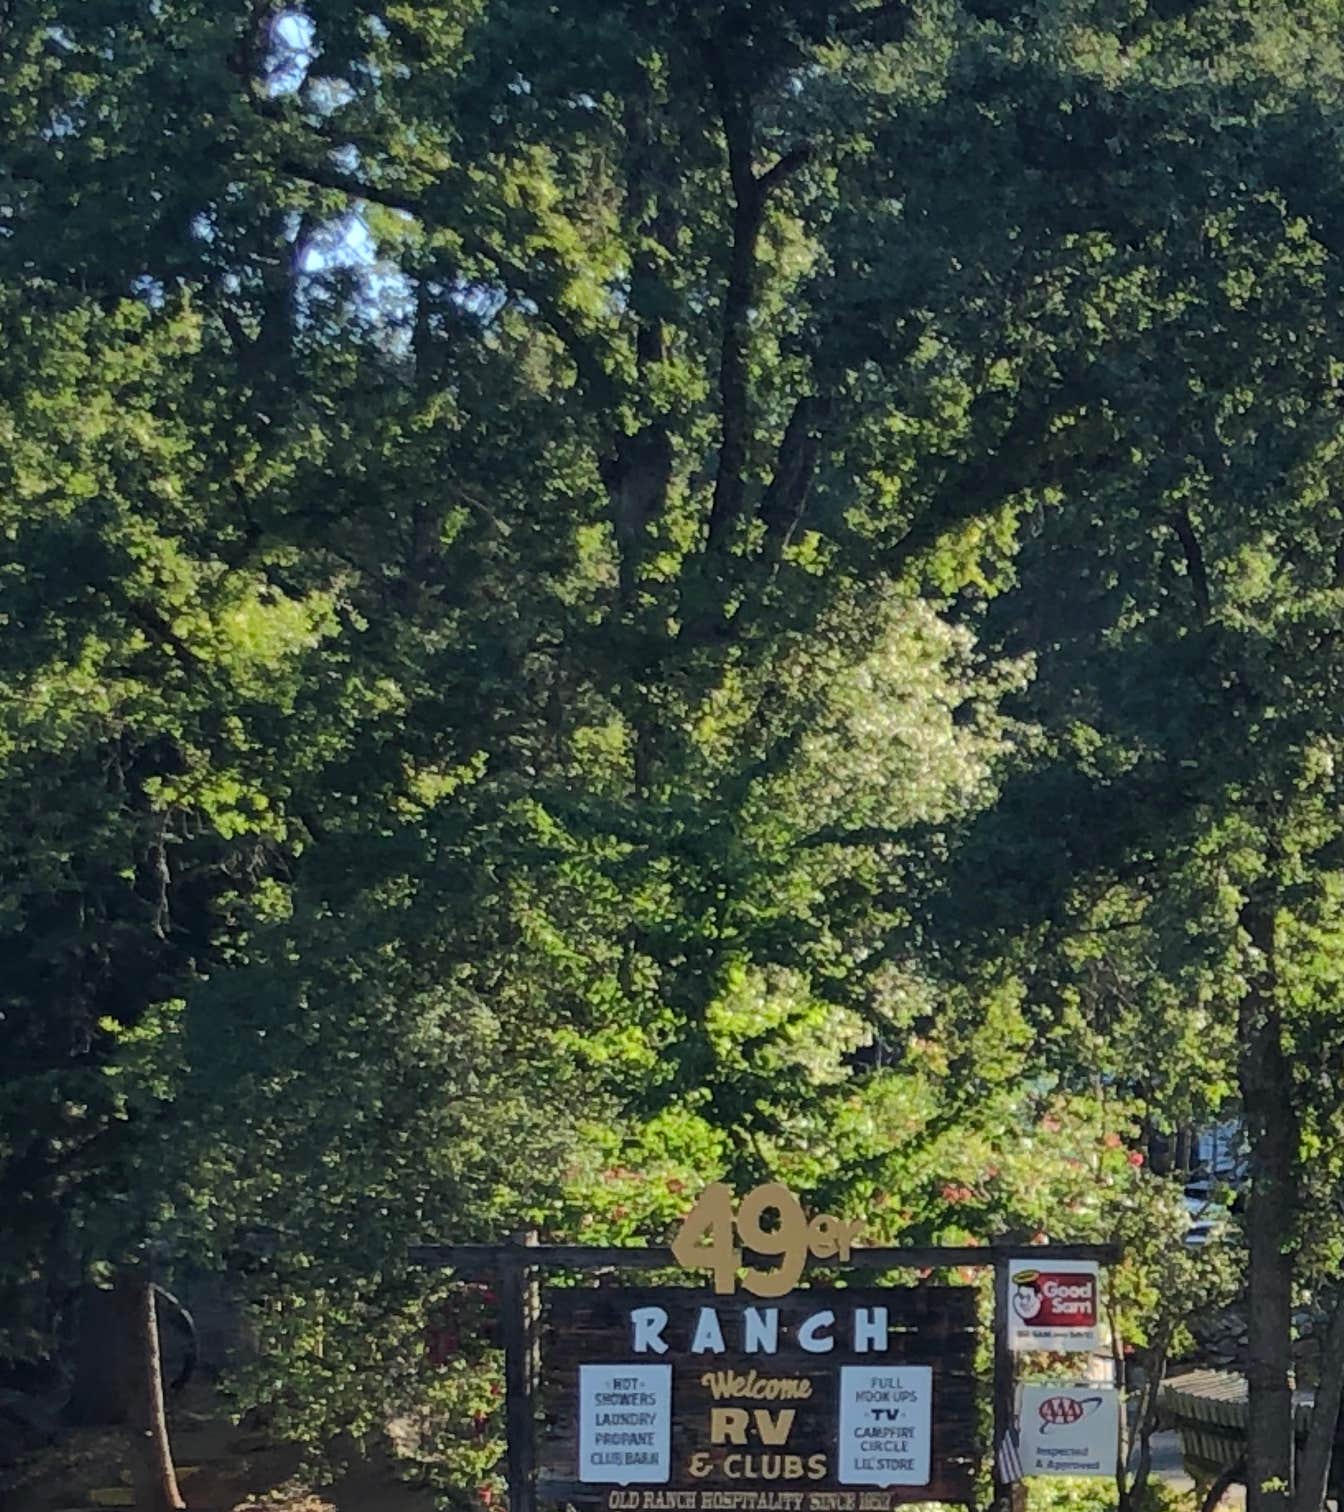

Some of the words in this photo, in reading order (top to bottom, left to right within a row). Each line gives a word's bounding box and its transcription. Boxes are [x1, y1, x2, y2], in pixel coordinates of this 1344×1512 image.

[1043, 1281, 1092, 1299] Good
[1051, 1298, 1092, 1314] Sam
[630, 1306, 888, 1354] RANCH
[613, 1378, 638, 1390] HOT
[702, 1370, 812, 1400] Welcome
[871, 1377, 903, 1389] FULL
[594, 1393, 656, 1406] SHOWERS
[595, 1412, 656, 1426] LAUNDRY
[870, 1408, 899, 1421] TV
[711, 1407, 795, 1445] RV
[854, 1427, 915, 1438] CAMPFIRE
[595, 1432, 655, 1446] PROPANE
[860, 1440, 908, 1452] CIRCLE
[690, 1455, 712, 1478] &
[723, 1454, 828, 1481] CLUBS
[876, 1458, 915, 1471] STORE
[608, 1491, 639, 1510] OLD
[643, 1491, 696, 1510] RANCH
[700, 1491, 804, 1511] HOSPITALITY
[809, 1491, 856, 1511] SINCE
